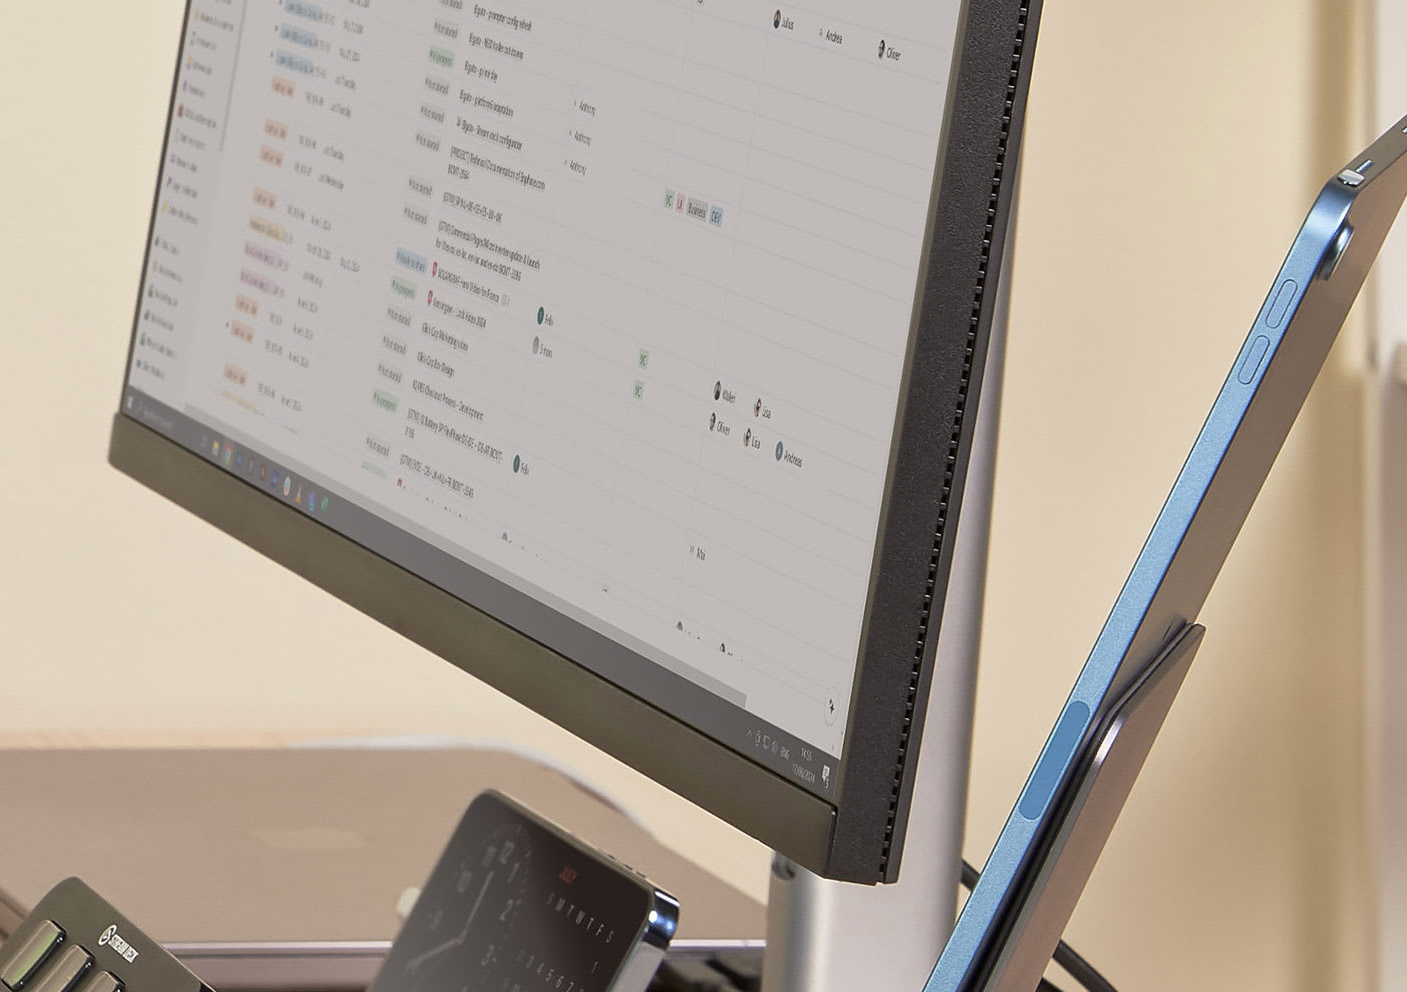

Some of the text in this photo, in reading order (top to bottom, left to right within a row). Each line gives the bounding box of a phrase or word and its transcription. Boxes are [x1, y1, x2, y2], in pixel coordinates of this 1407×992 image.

[824, 28, 843, 45] Andrea
[886, 46, 902, 62] Oliver
[716, 421, 730, 436] Oliver
[750, 437, 802, 468] Lisa Andreas
